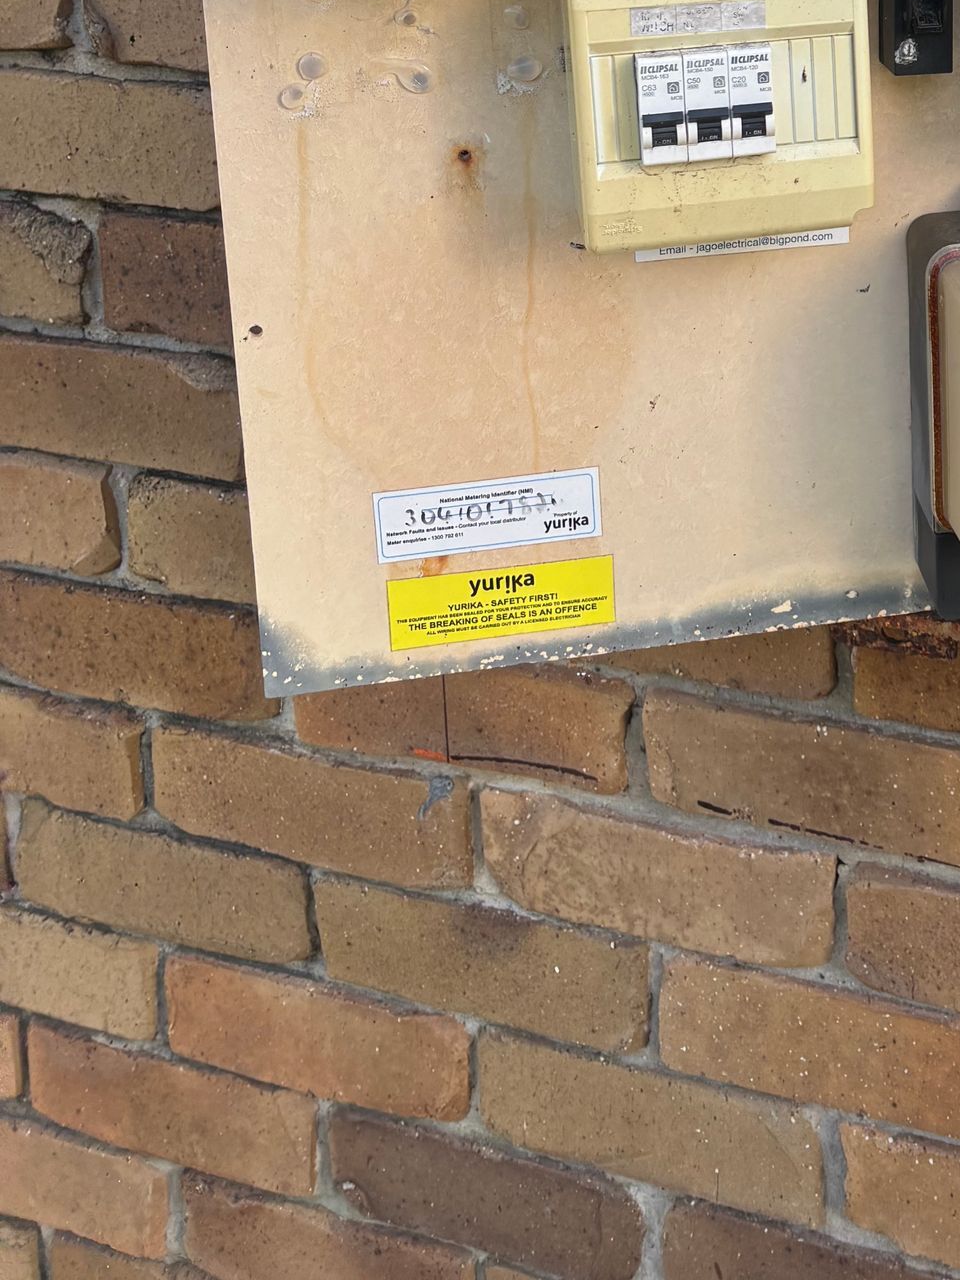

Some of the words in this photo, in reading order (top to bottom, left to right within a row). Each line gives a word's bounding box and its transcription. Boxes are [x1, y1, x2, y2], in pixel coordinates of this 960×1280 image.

[694, 58, 725, 68] CLIPSAL
[739, 53, 769, 63] CLIPSAL
[648, 63, 679, 74] CLIPSAL
[686, 77, 701, 85] C50
[731, 76, 747, 84] C20
[641, 84, 657, 92] C63
[659, 244, 687, 256] Email
[696, 232, 833, 254] jagoelectrical@bigpond.com
[440, 496, 464, 504] National
[491, 490, 517, 498] Identifier
[503, 516, 527, 524] distributor
[448, 601, 484, 612] YURIKA
[491, 596, 527, 607] SAFETY
[529, 593, 558, 602] FIRST!
[408, 622, 427, 631] THE
[430, 617, 478, 629] BREAKING
[481, 615, 494, 623] OF
[496, 611, 526, 621] SEALS
[528, 610, 538, 618] IS
[540, 608, 553, 616] AN
[554, 603, 598, 614] OFFENCE
[409, 615, 437, 623] EQUIPMENT
[510, 603, 541, 611] PROTECTION
[549, 613, 581, 621] ELECTRICIAN
